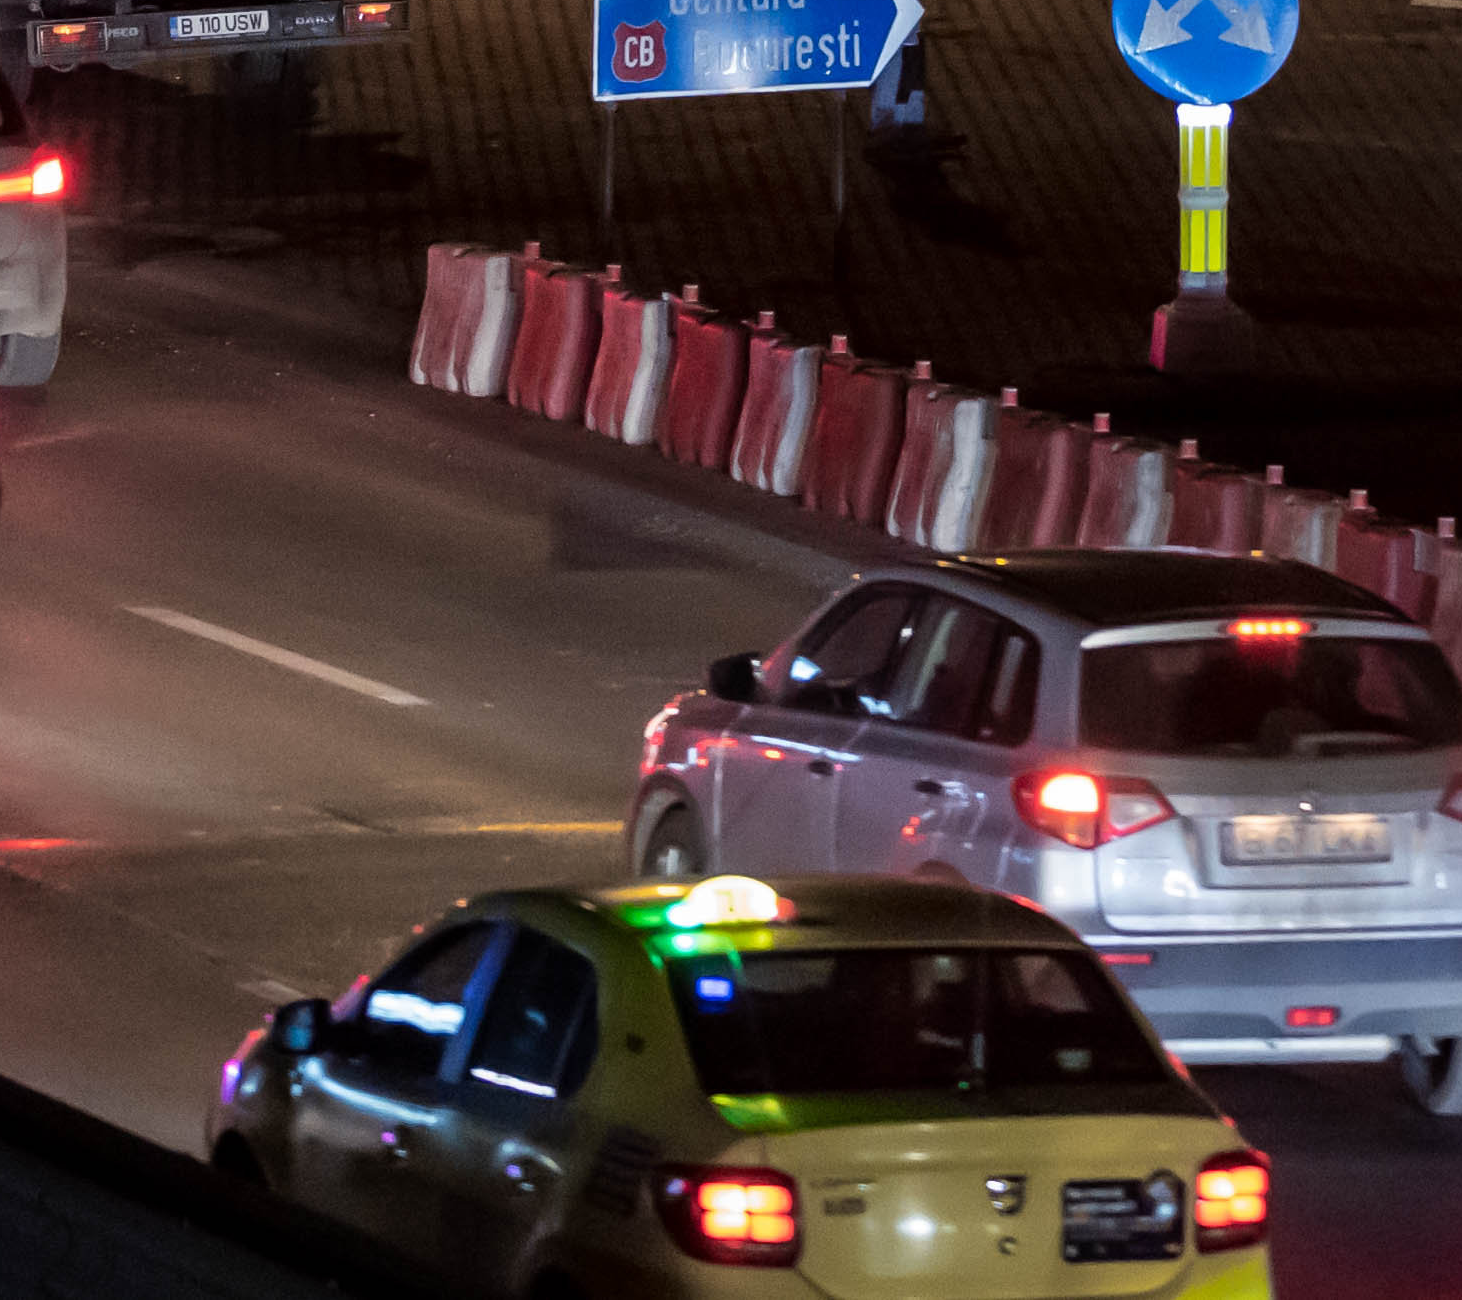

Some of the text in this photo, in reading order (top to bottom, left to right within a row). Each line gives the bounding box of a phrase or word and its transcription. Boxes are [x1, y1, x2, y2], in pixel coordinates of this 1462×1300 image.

[181, 12, 263, 35] B 110 USW
[624, 35, 655, 68] CB
